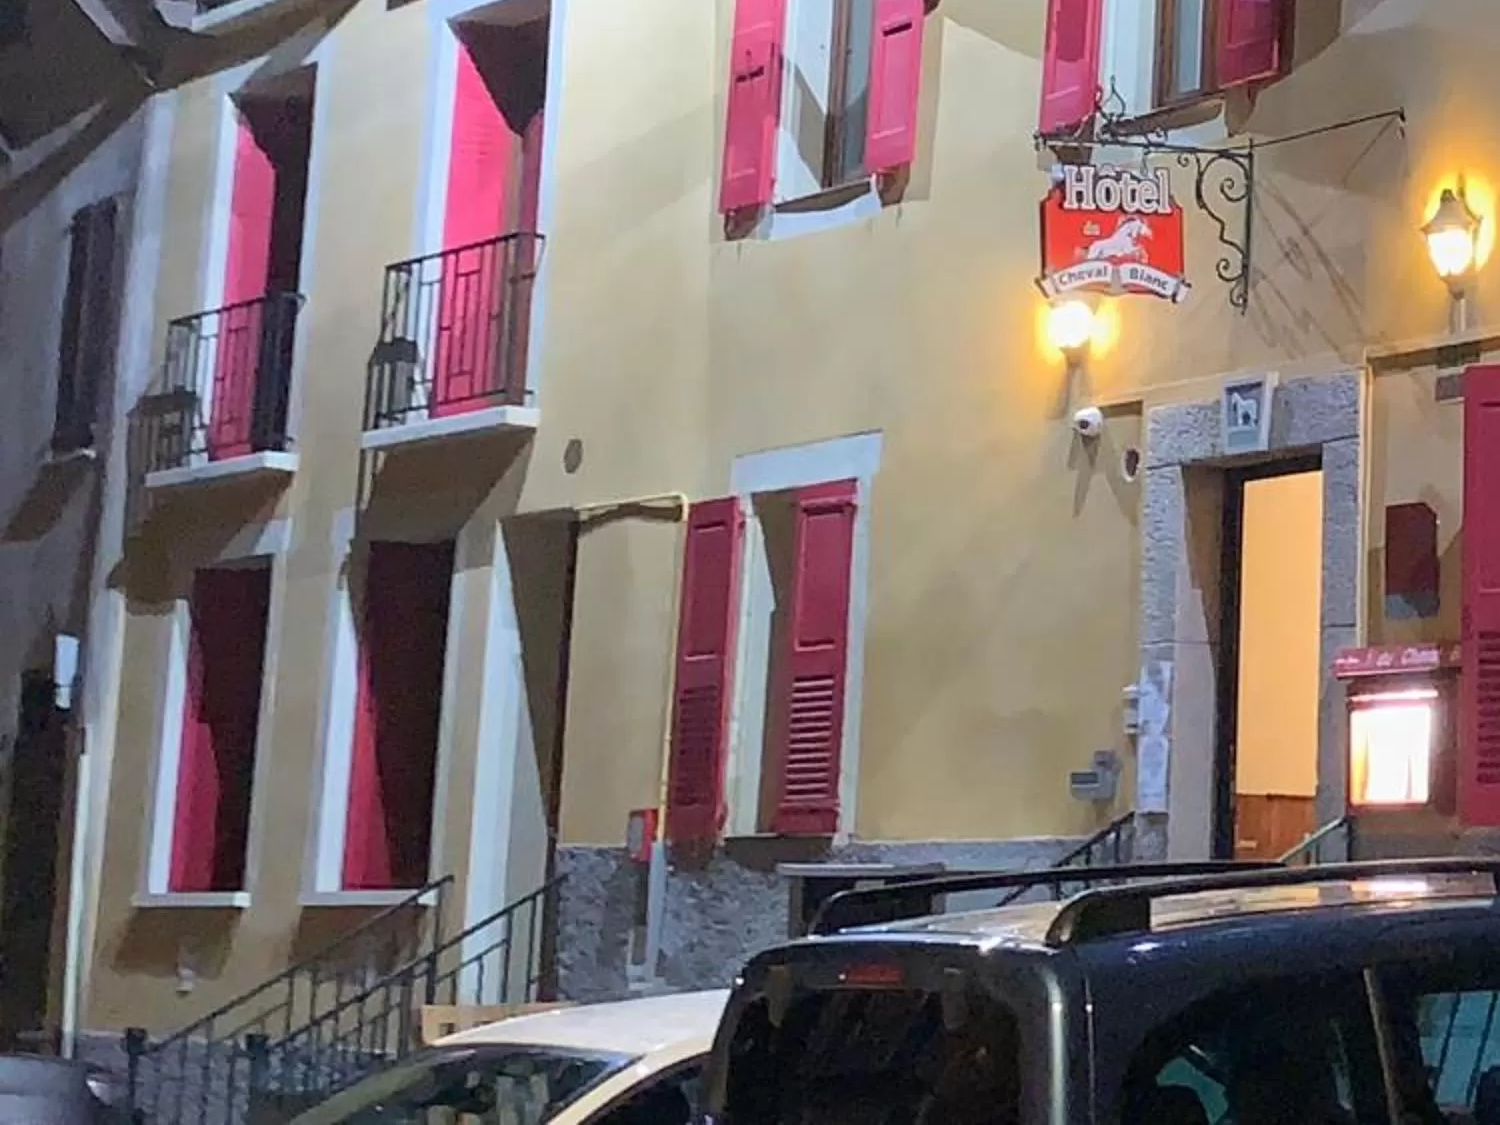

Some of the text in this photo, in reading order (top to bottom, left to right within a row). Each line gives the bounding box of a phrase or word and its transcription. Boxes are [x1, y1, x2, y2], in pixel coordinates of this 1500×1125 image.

[1063, 164, 1172, 214] Hôtel
[1059, 266, 1169, 291] Cheval Blanc
